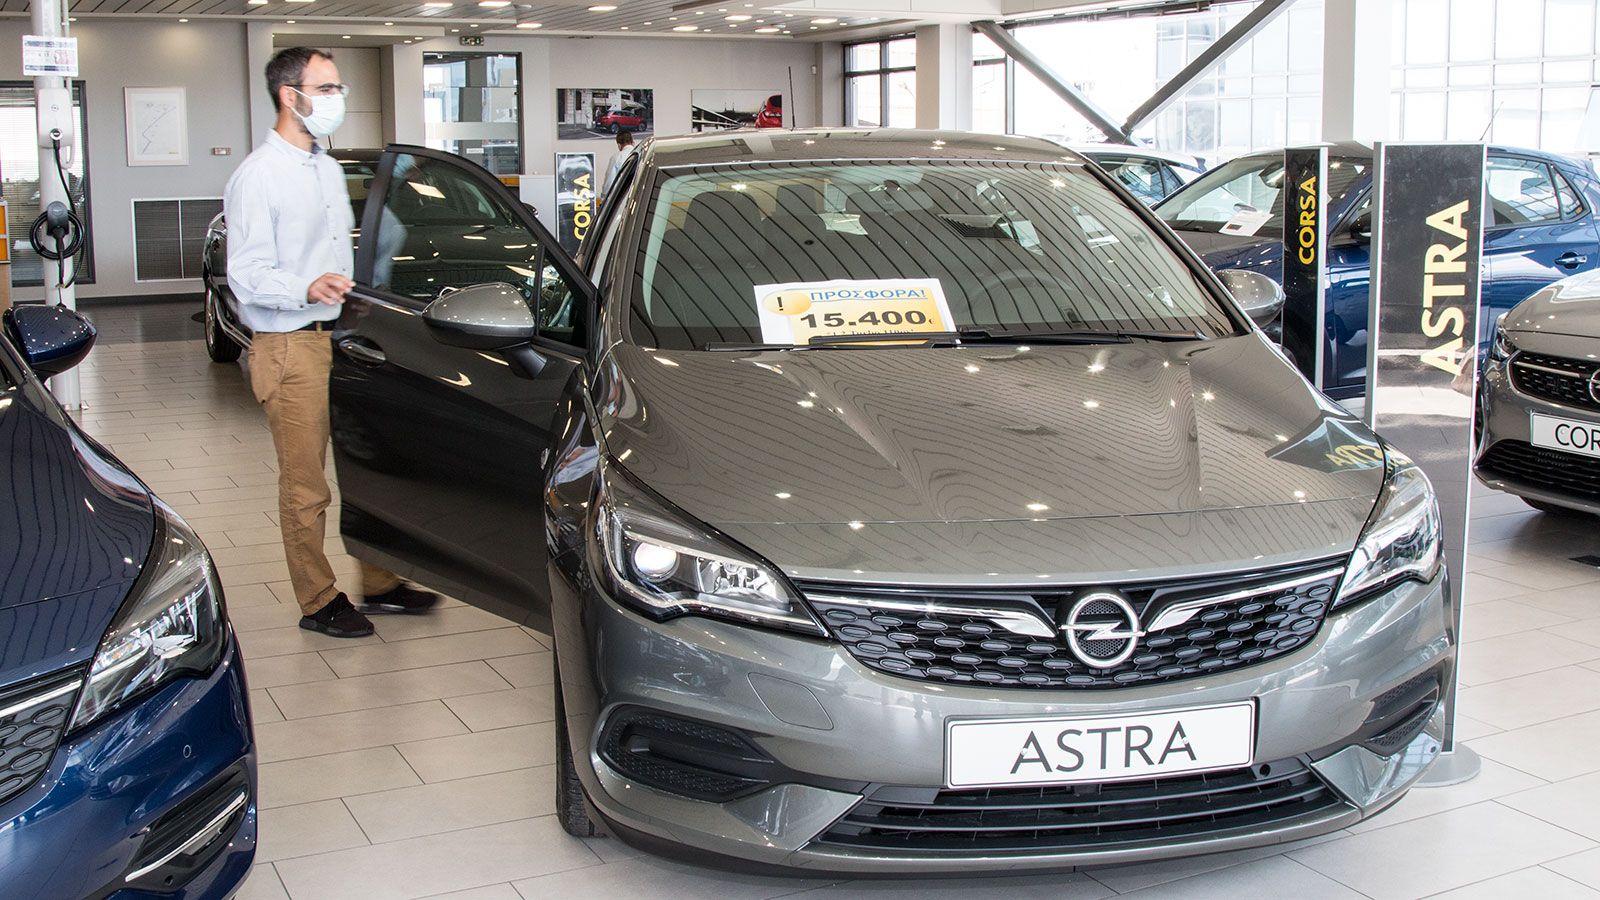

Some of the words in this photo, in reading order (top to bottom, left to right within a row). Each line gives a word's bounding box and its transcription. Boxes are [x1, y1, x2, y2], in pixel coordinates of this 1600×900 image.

[573, 173, 591, 240] CORSA
[1299, 176, 1317, 265] CORSA
[810, 289, 927, 301] ΠΡΟΣΦΟΡΑ!
[1420, 199, 1470, 377] ASTRA
[1010, 720, 1198, 774] ASTRA
